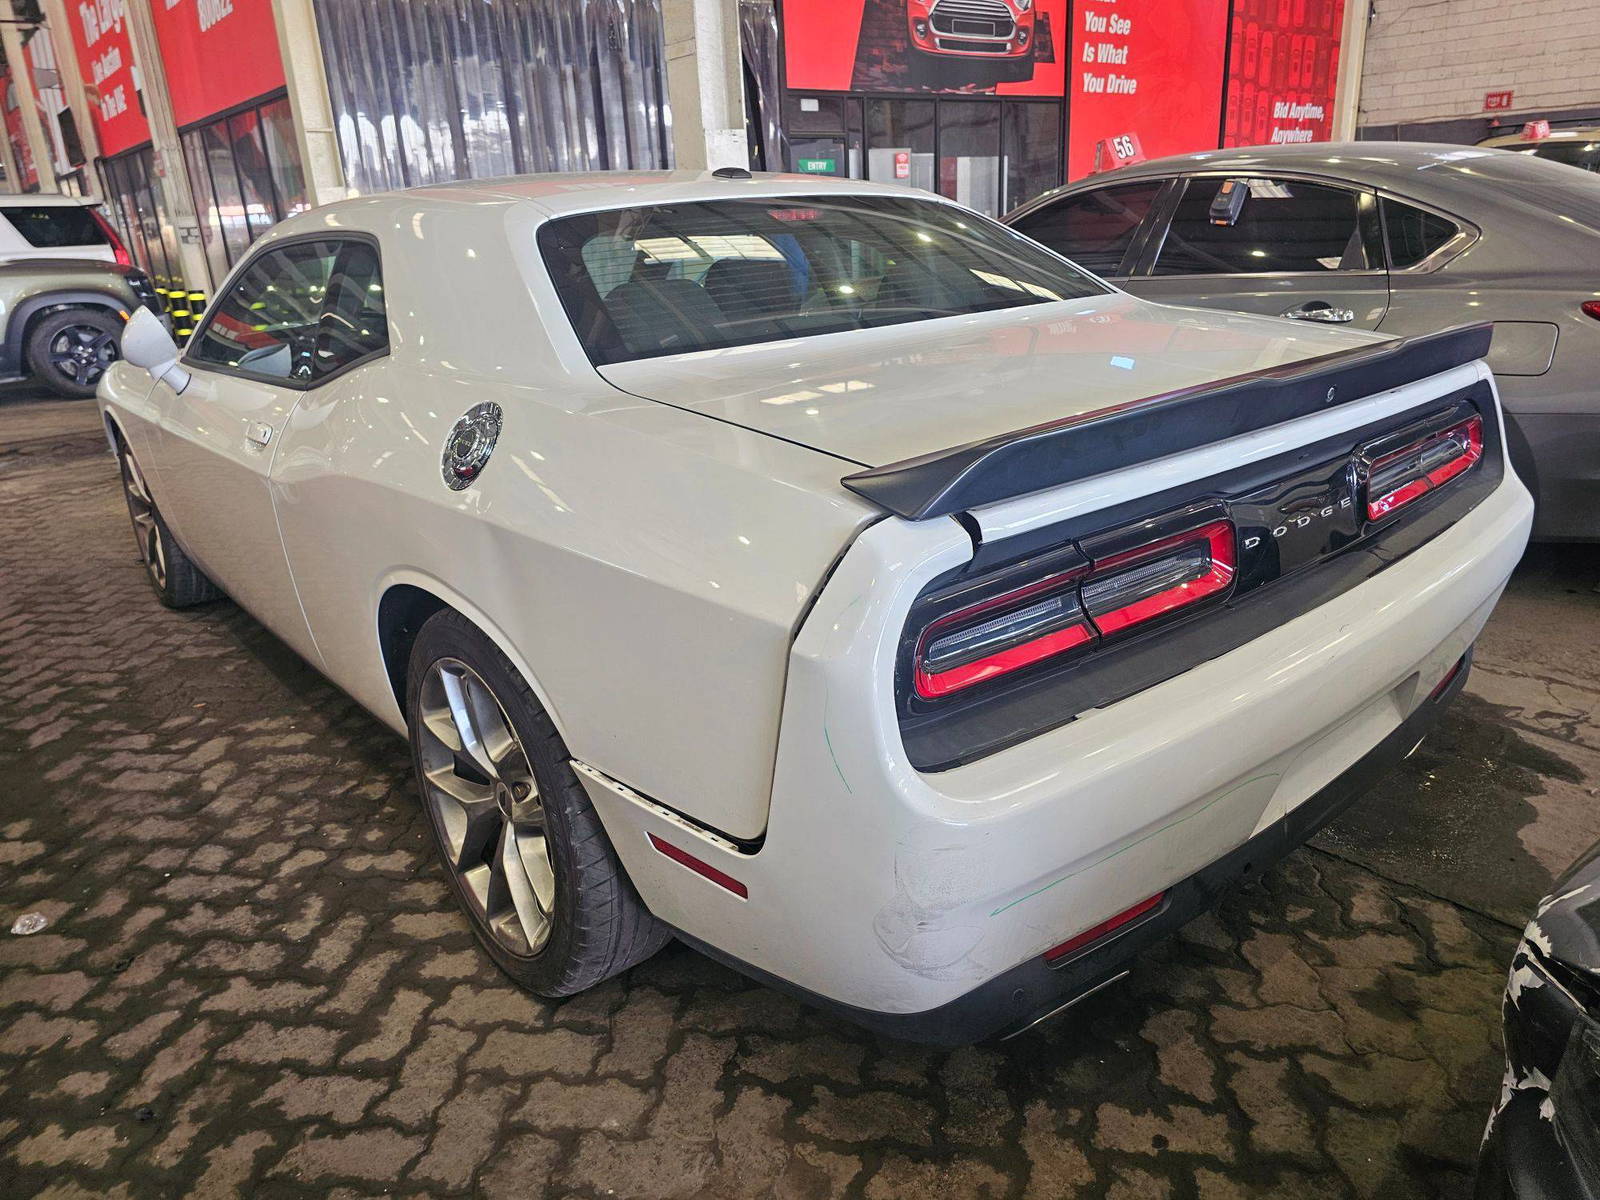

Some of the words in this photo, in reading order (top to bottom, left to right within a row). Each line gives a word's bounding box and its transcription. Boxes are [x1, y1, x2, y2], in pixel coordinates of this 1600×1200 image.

[1084, 10, 1108, 33] You
[1108, 12, 1132, 36] See
[1082, 41, 1096, 64] Is
[1097, 42, 1129, 65] What
[1082, 72, 1106, 94] You
[1106, 73, 1138, 95] Drive
[1273, 101, 1290, 119] Bid
[1111, 135, 1136, 160] 56
[1270, 127, 1313, 145] Anywhere
[807, 161, 827, 171] ENTRY
[1244, 496, 1351, 550] DODGE
